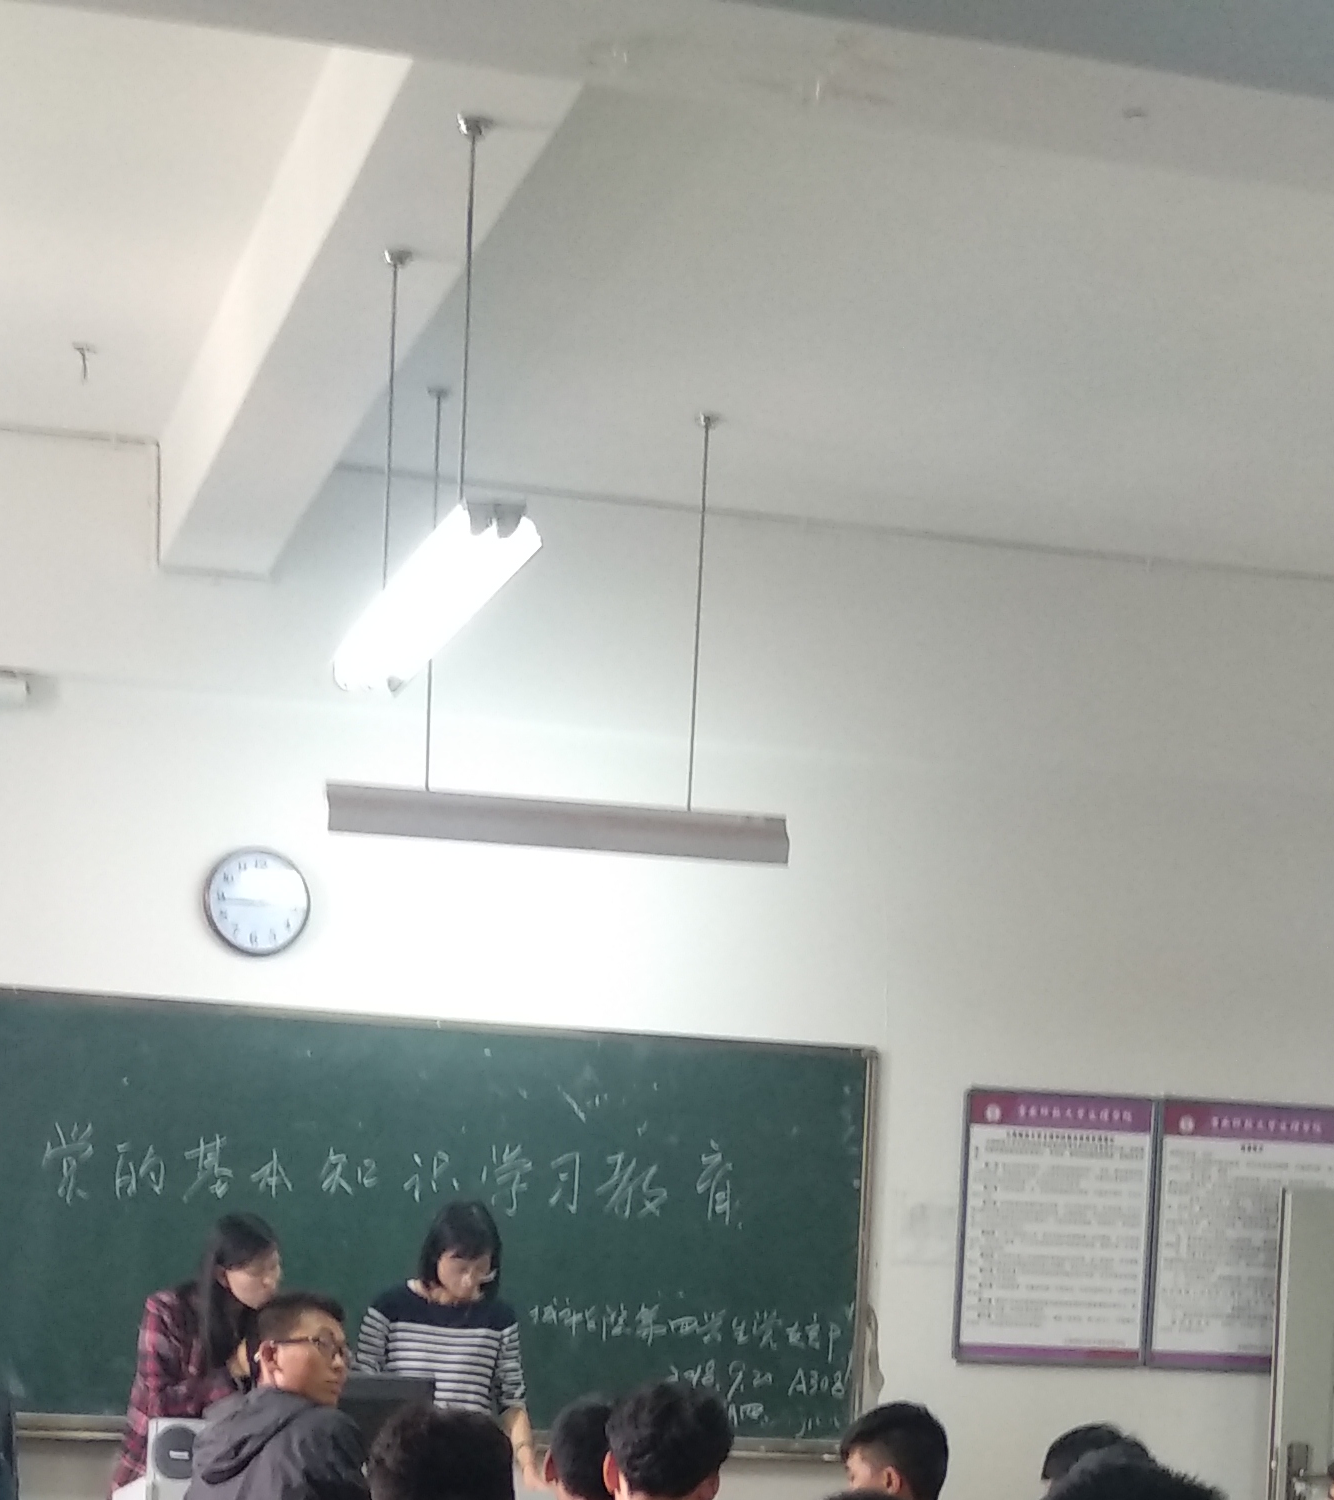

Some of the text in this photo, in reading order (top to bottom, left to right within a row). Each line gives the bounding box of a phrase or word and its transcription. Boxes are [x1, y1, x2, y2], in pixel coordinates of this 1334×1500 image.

[42, 1121, 734, 1226] 党的基本知识学习教育
